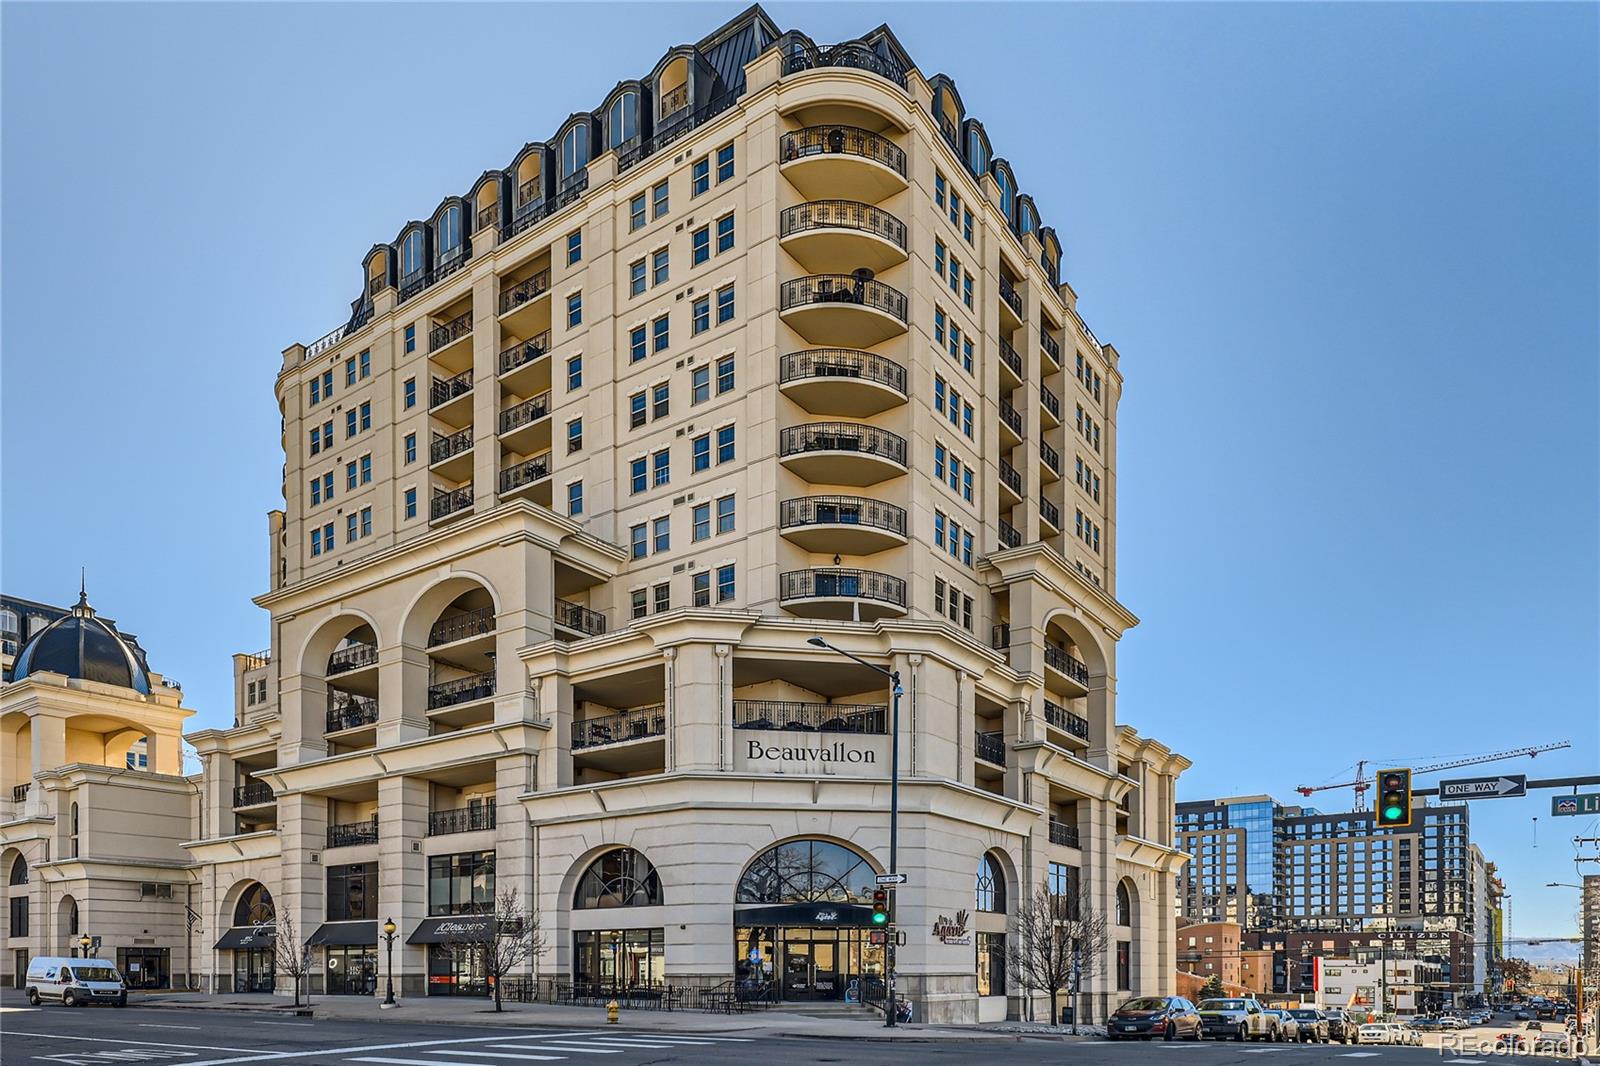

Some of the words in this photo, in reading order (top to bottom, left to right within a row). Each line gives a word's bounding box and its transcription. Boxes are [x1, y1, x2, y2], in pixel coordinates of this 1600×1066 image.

[747, 740, 876, 764] Beauvallon
[1447, 783, 1471, 794] ONE
[1474, 782, 1499, 792] WAY
[1584, 796, 1600, 811] Li
